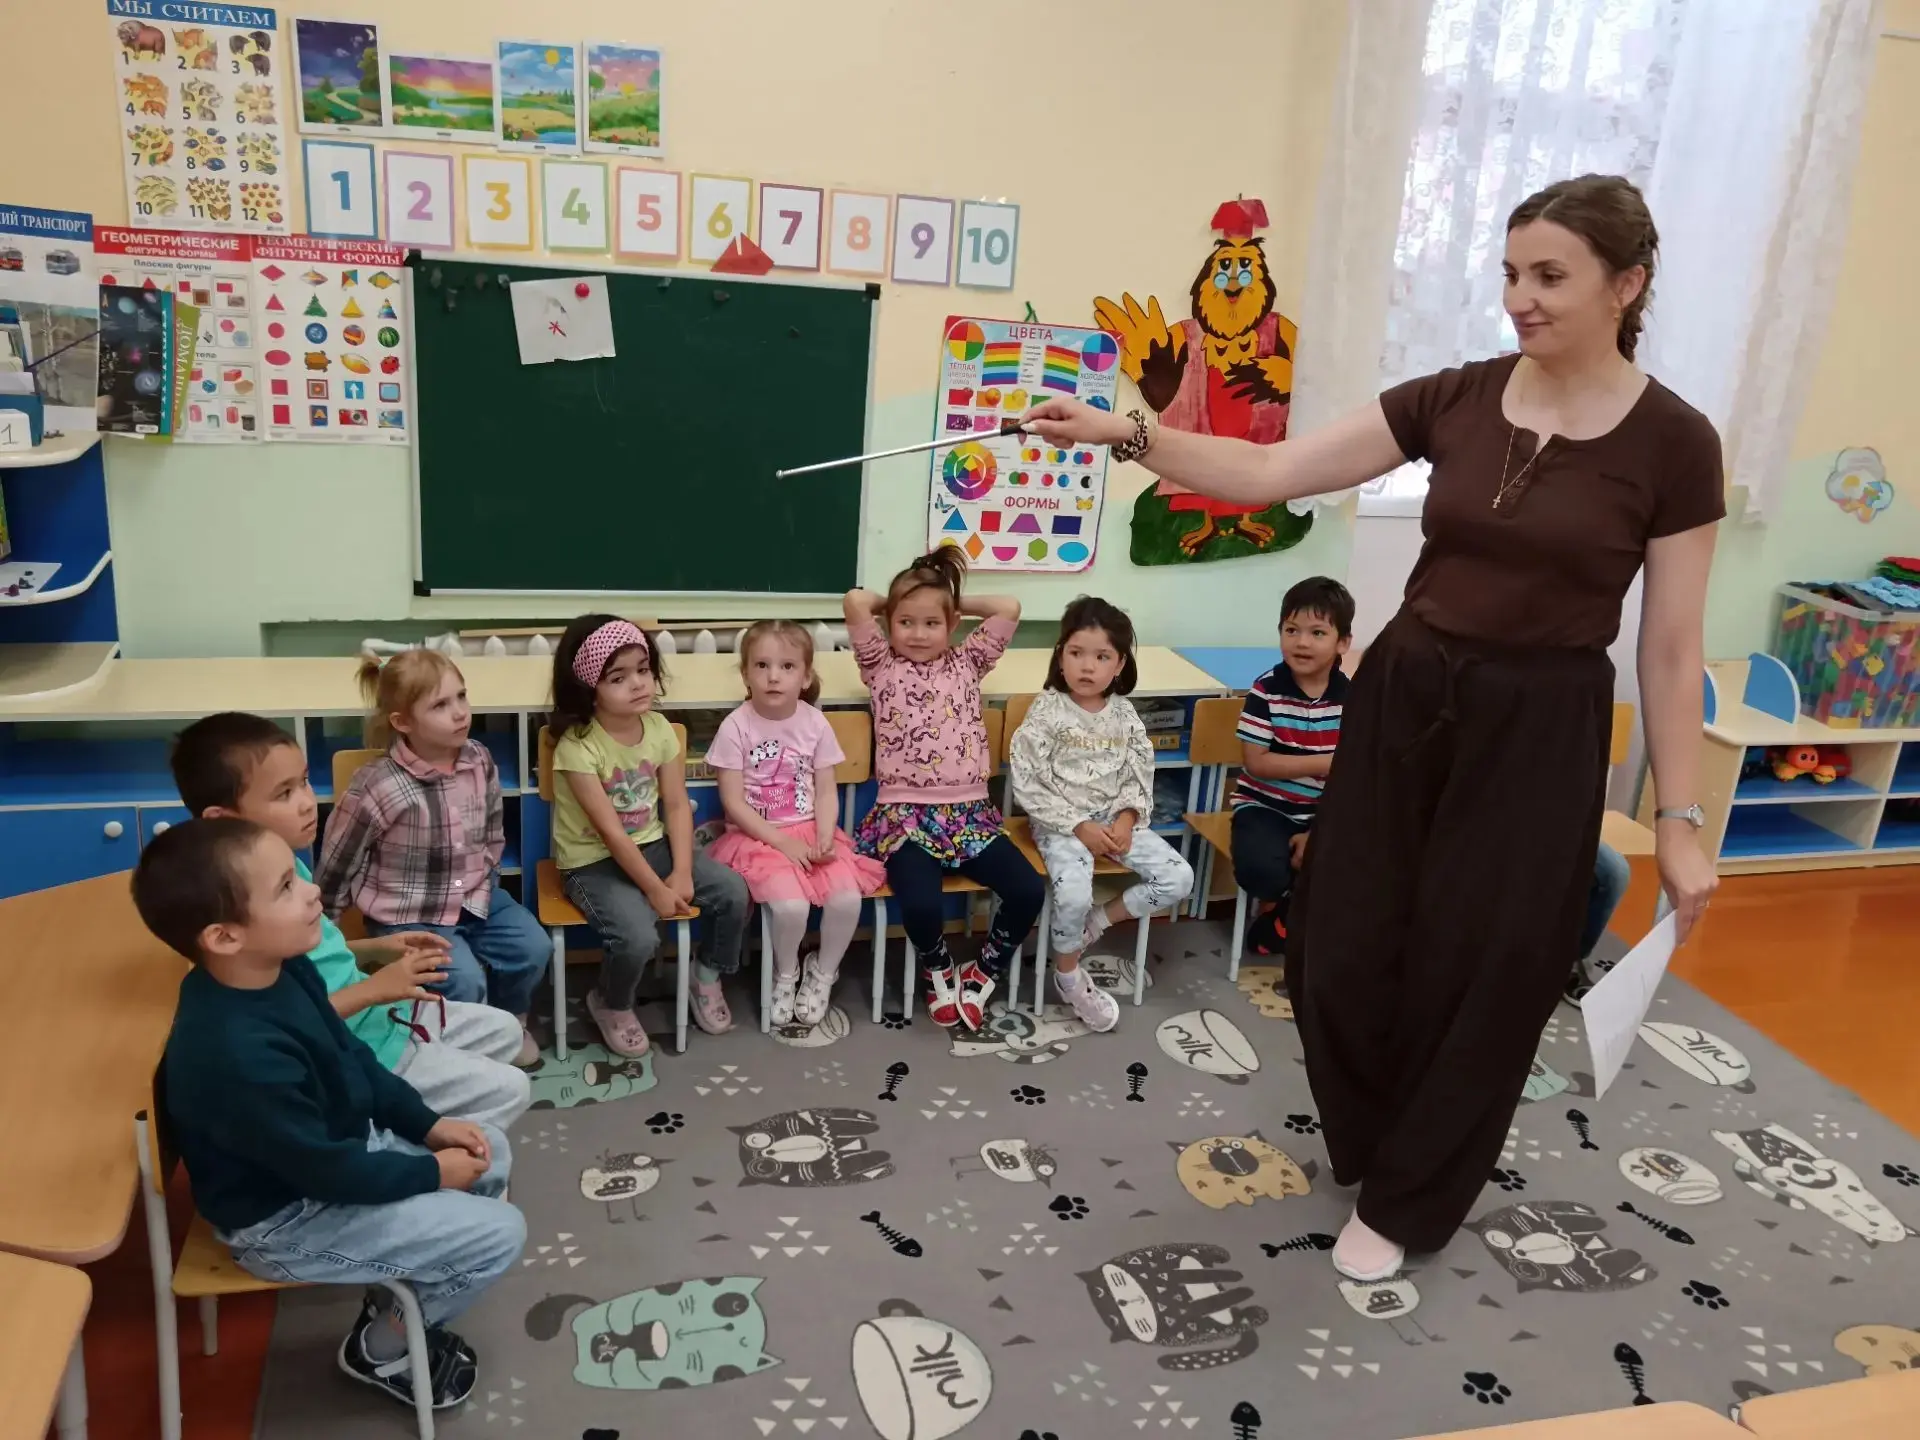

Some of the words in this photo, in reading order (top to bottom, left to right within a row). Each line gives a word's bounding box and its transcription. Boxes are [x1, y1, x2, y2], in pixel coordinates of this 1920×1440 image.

[113, 0, 152, 16] МЫ
[161, 4, 270, 26] СЧИТАЕМ
[122, 51, 129, 65] 1
[177, 56, 186, 70] 2
[232, 61, 240, 74] 3
[126, 102, 135, 116] 4
[183, 107, 191, 120] 5
[236, 111, 245, 124] 6
[132, 153, 140, 166] 7
[187, 156, 196, 170] 8
[240, 160, 249, 173] 9
[331, 170, 351, 211] 1
[136, 201, 152, 215] 10
[407, 181, 433, 221] 2
[485, 182, 512, 221] 3
[562, 188, 591, 225] 4
[190, 204, 204, 218] 11
[242, 208, 258, 221] 12
[637, 194, 662, 231] 5
[707, 202, 733, 239] 6
[21, 214, 87, 233] ТРАНСПОРТ
[779, 210, 803, 245] 7
[101, 231, 240, 250] ГЕОМЕТРИЧЕСКИЕ
[846, 216, 872, 251] 8
[910, 223, 935, 259] 9
[125, 246, 167, 256] ФИГУРЫ
[169, 248, 176, 257] И
[178, 249, 217, 258] ФОРМЫ
[967, 227, 1009, 265] 10
[134, 259, 173, 269] Плоские
[176, 262, 211, 273] фигуры
[256, 247, 320, 260] ФИГУРЫ
[327, 252, 337, 262] И
[342, 253, 401, 266] ФОРМЫ
[1009, 326, 1053, 340] ЦВЕТА
[1, 424, 20, 445] 1
[1004, 495, 1060, 510] ФОРМЫ
[1163, 1025, 1213, 1065] milk
[1682, 1030, 1745, 1069] milk
[910, 1332, 978, 1409] milk
